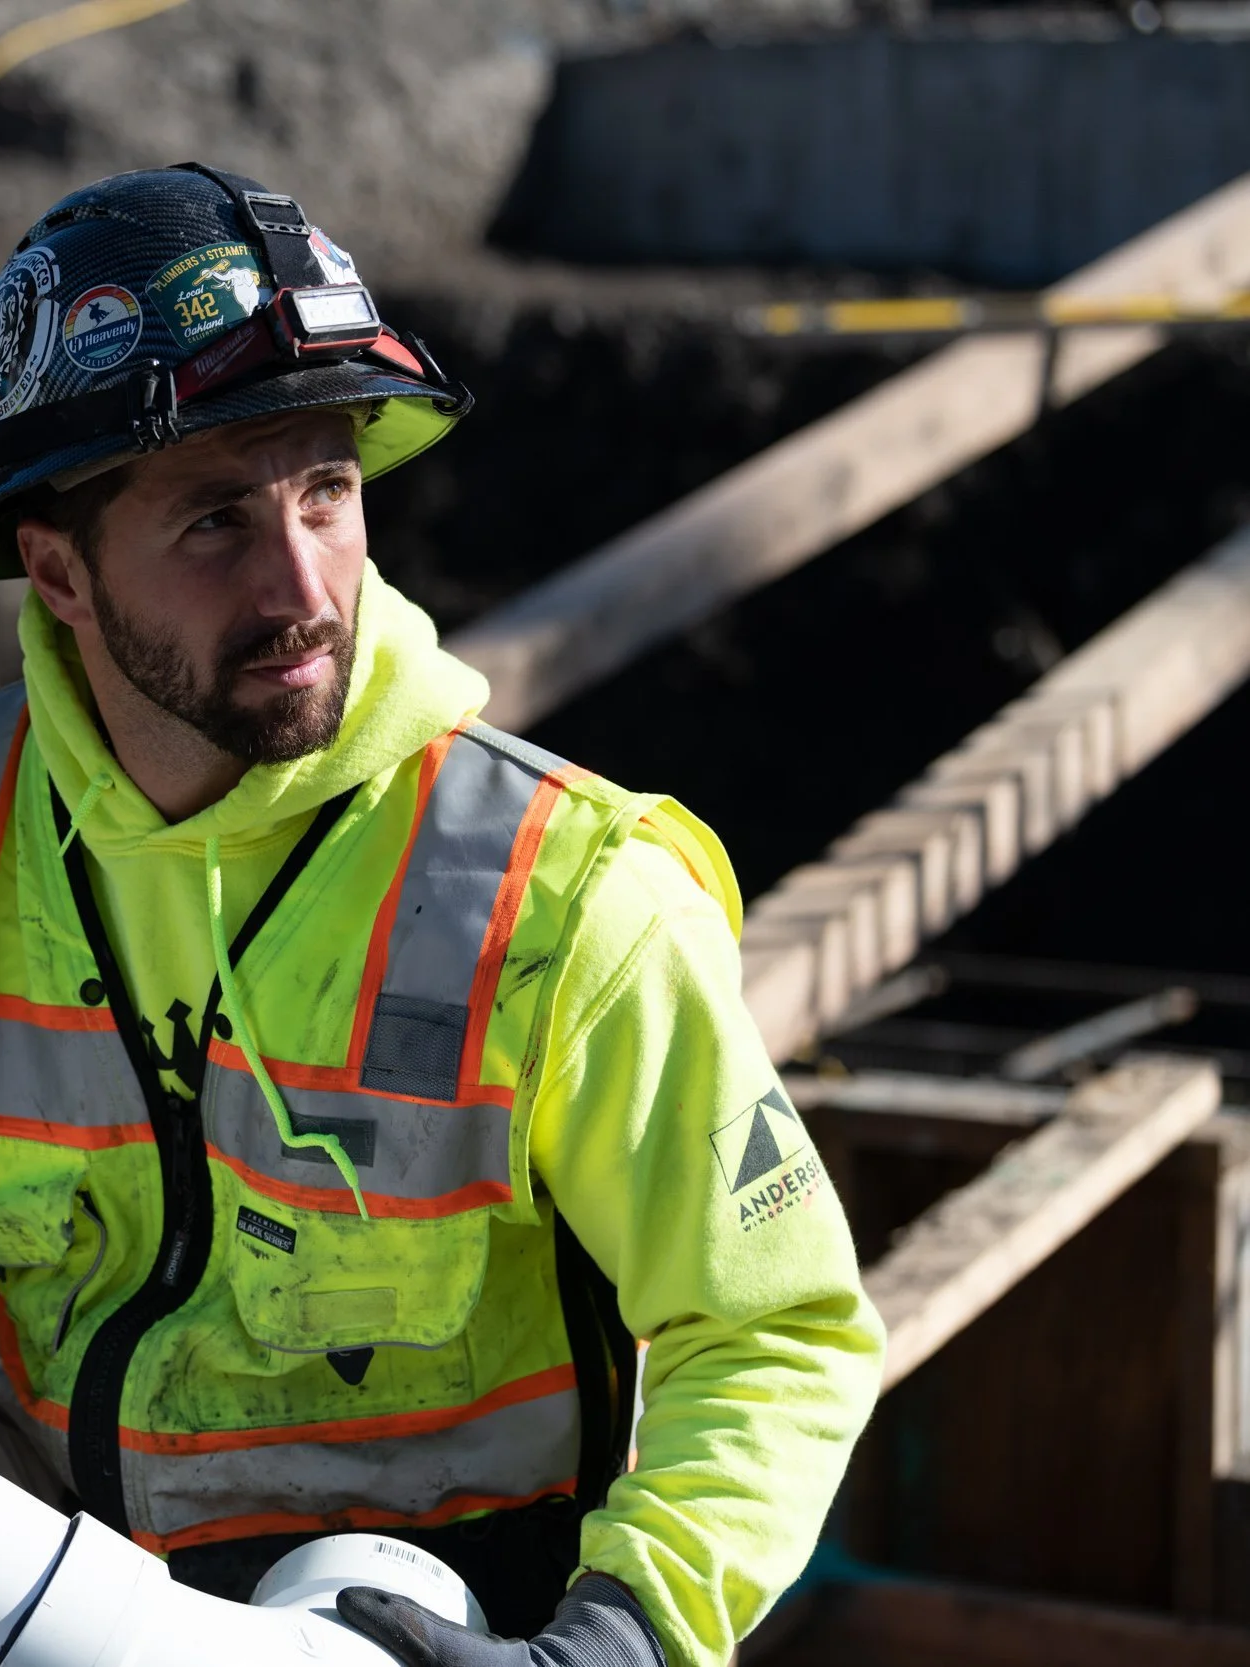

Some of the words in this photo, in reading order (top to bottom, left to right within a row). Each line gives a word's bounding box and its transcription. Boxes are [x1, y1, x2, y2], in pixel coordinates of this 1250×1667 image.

[153, 255, 200, 292] PLUMBERS
[177, 284, 204, 302] Local
[174, 292, 219, 327] 342
[85, 321, 137, 347] Heavenly
[184, 315, 224, 337] Oakland
[81, 341, 131, 366] CALIFORNIA
[247, 1213, 284, 1234] PREMIUM
[743, 1196, 801, 1232] WINDOWS
[238, 1219, 263, 1238] BLACK
[166, 1241, 183, 1280] KISHIGO
